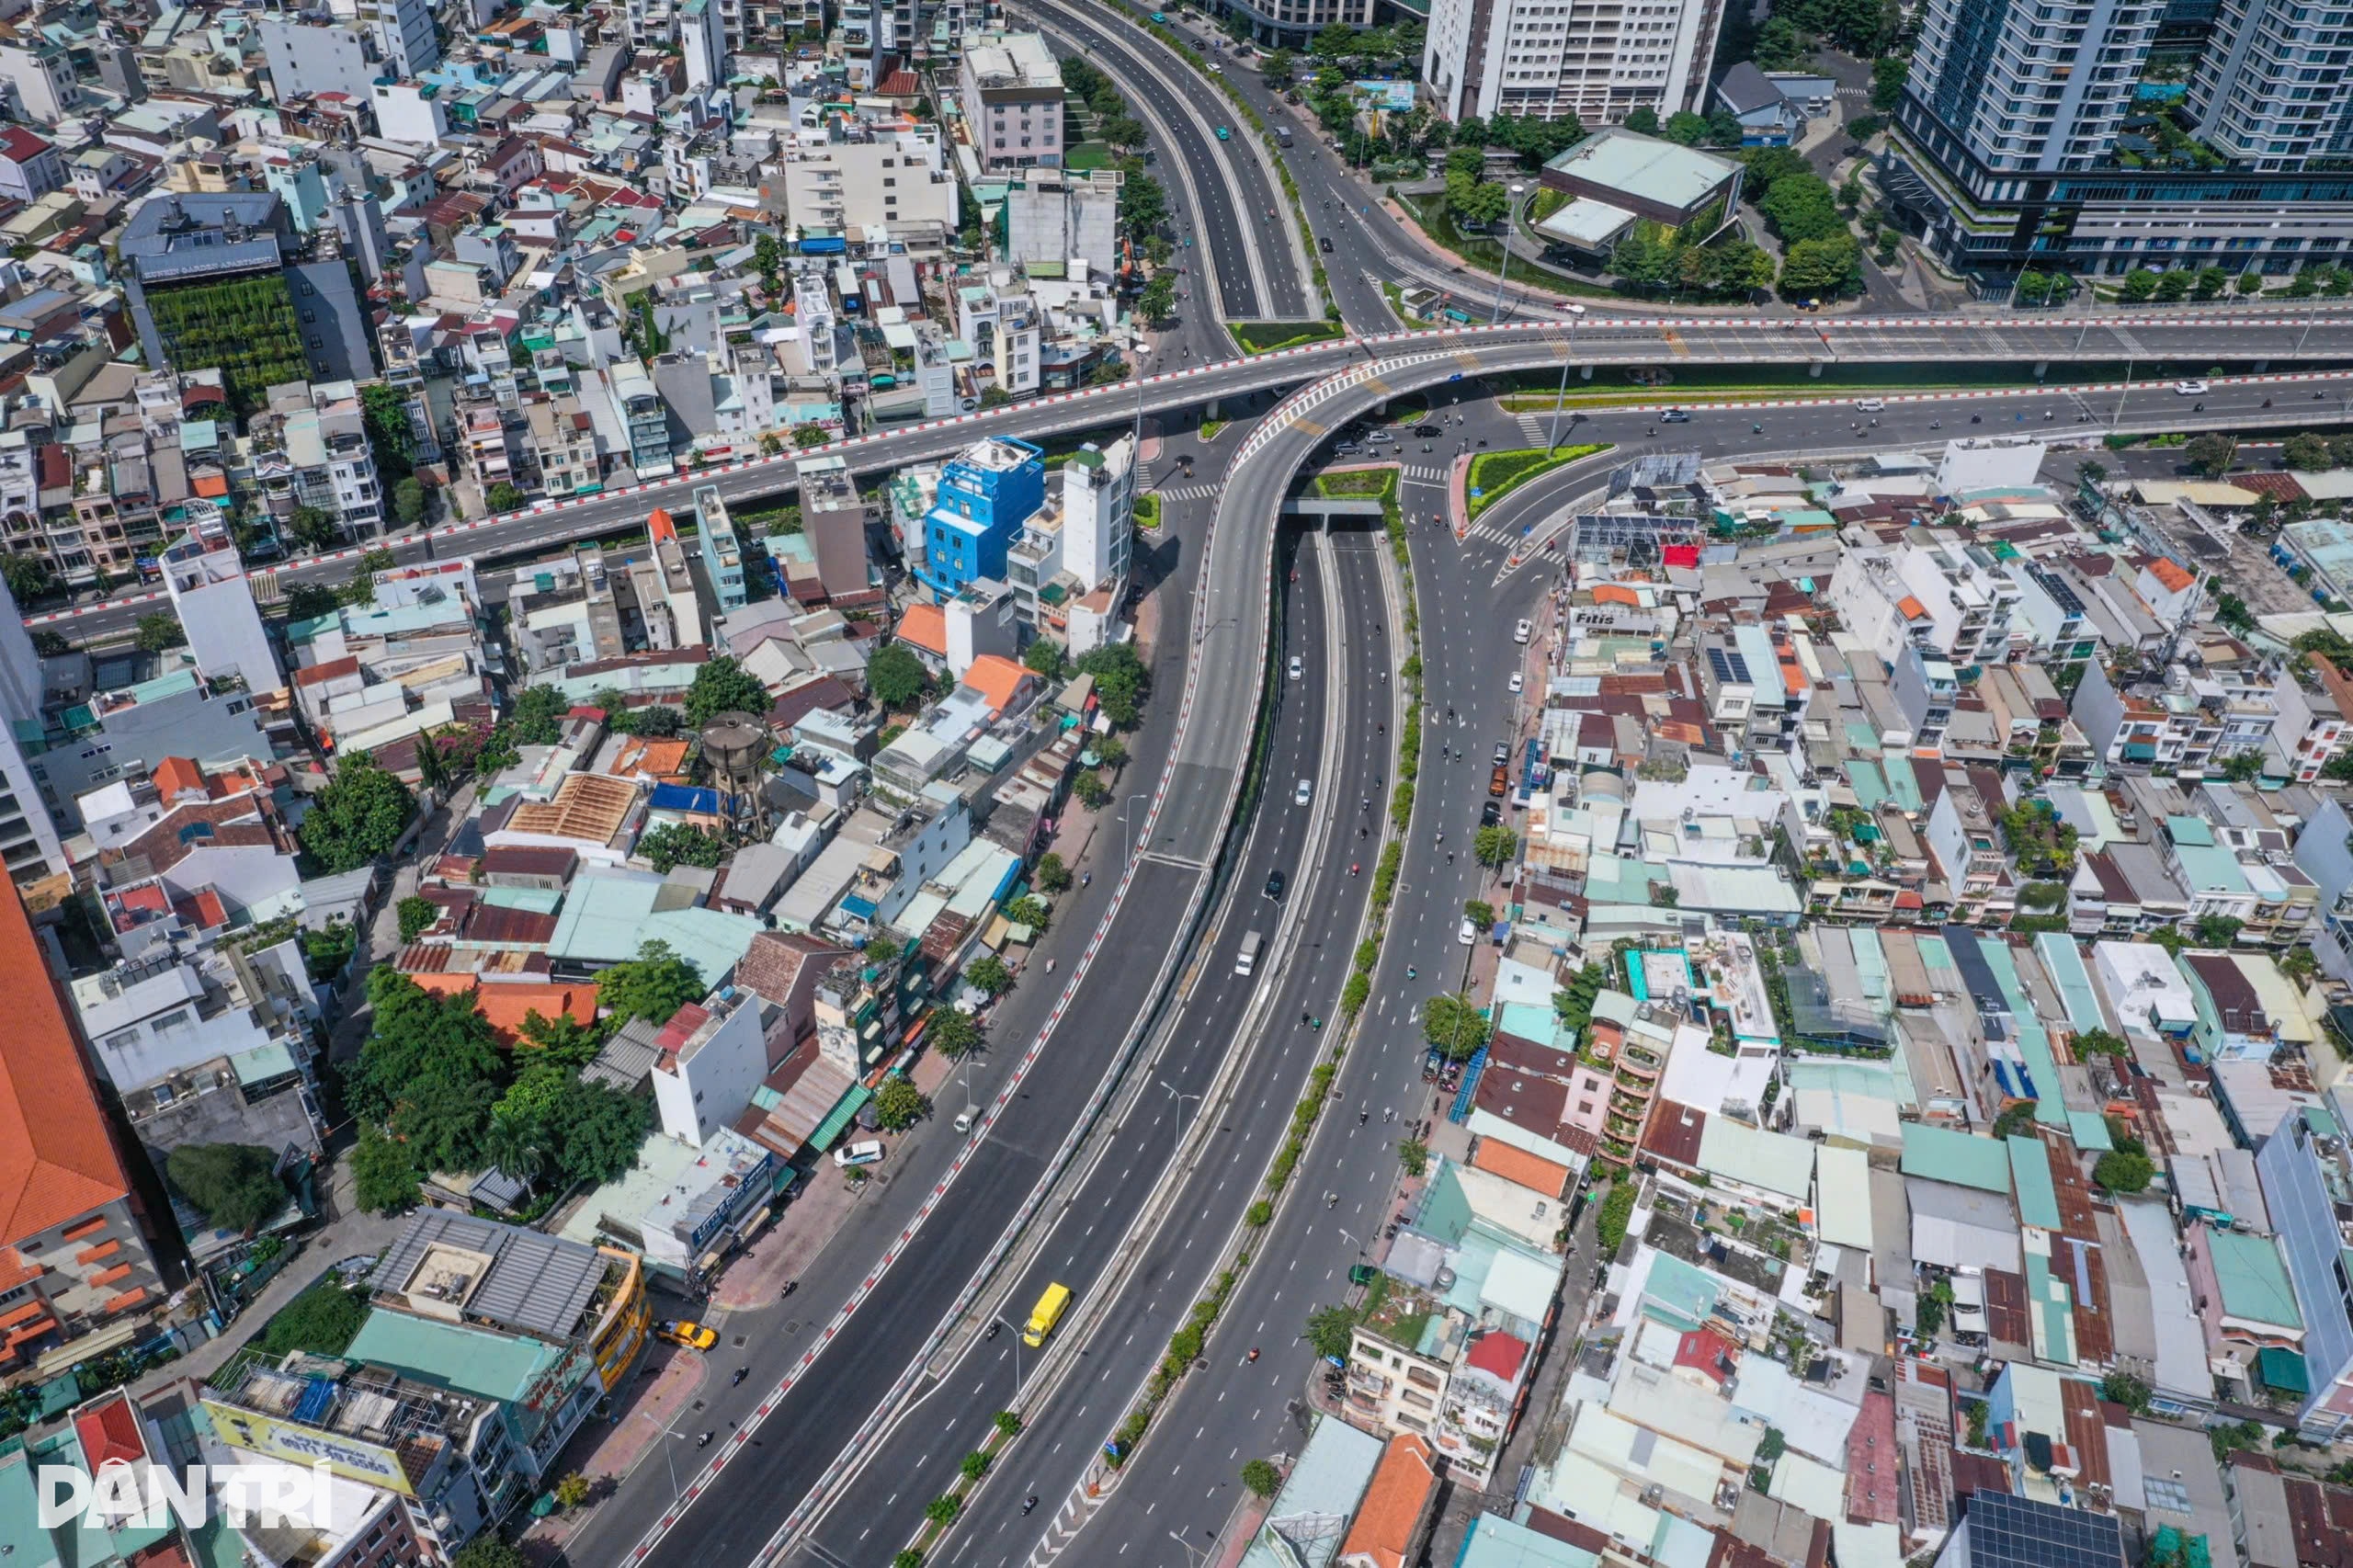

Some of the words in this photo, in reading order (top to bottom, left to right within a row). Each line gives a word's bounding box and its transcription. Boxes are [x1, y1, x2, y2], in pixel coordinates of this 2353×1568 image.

[182, 263, 219, 273] GARDEN
[220, 256, 273, 268] APARTMENT
[1575, 613, 1614, 624] Fitis
